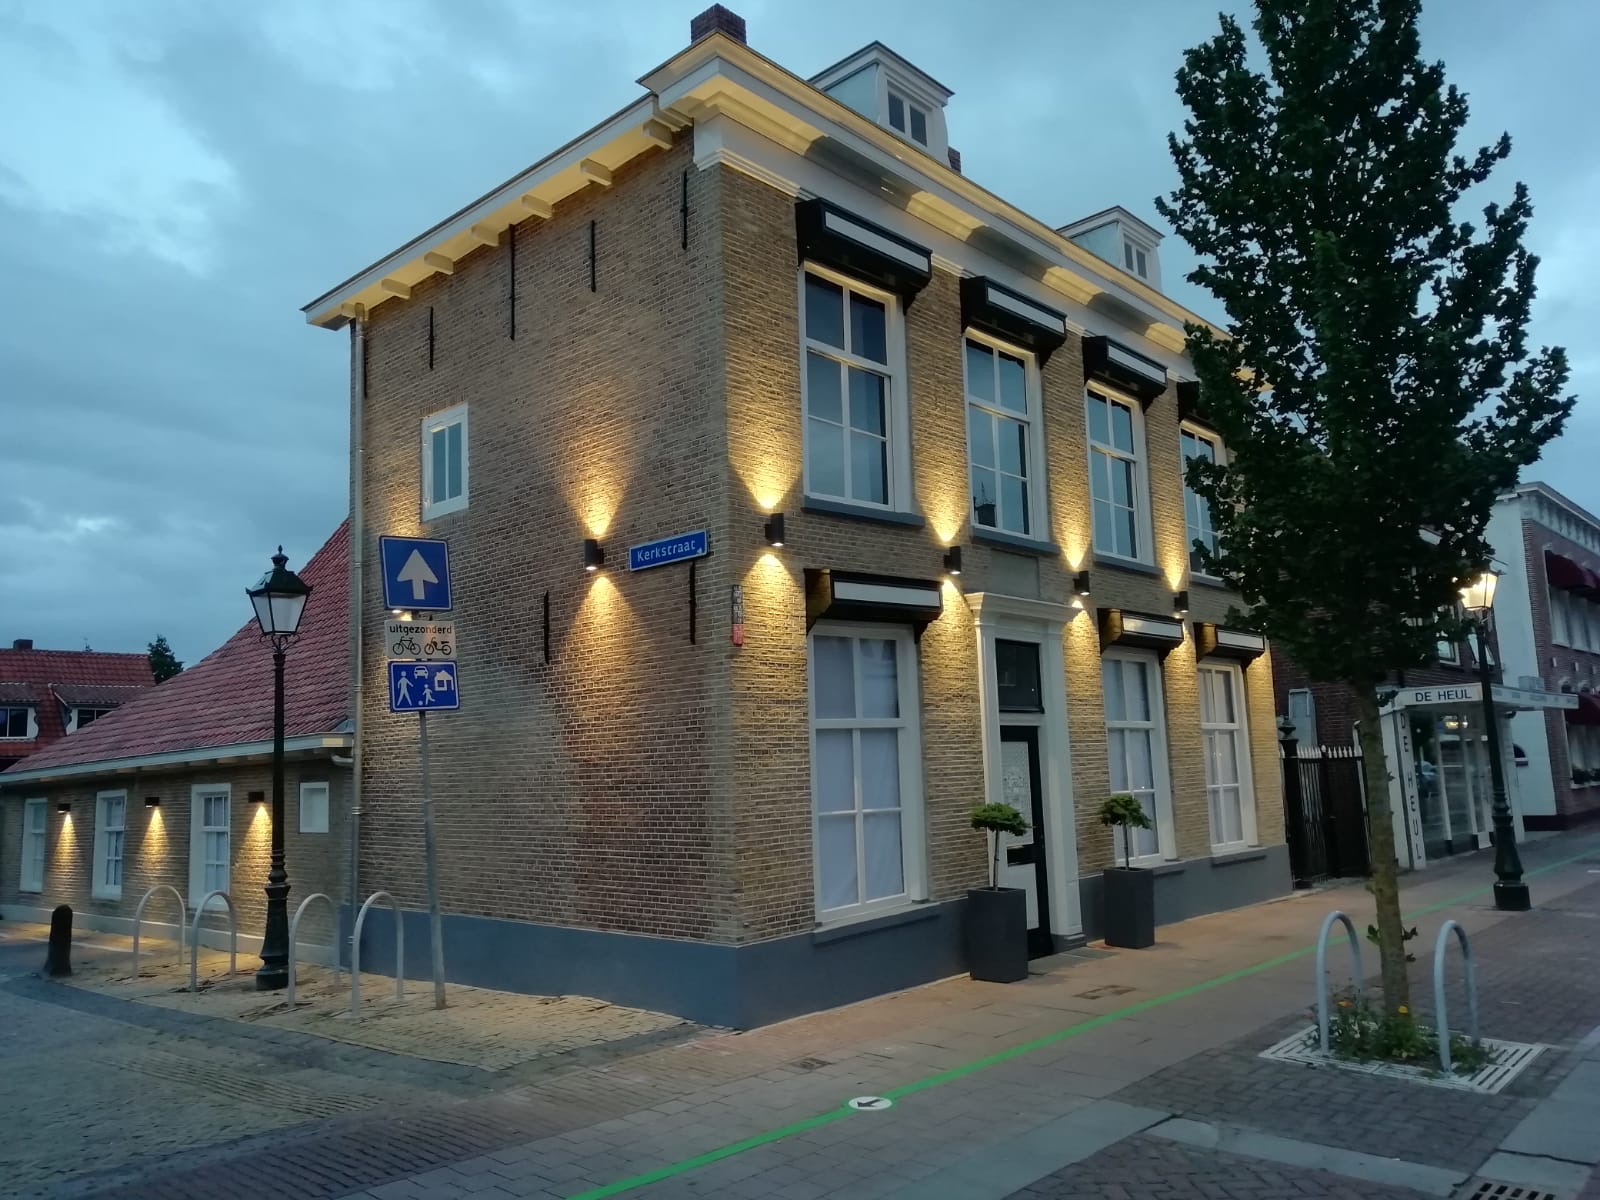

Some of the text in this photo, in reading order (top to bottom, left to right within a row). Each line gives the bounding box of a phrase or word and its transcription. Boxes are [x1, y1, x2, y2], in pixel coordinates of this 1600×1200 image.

[637, 540, 696, 562] Kerkstraat
[389, 623, 452, 635] uitgezonderd
[1415, 689, 1472, 702] DE HEUL
[1400, 713, 1422, 860] DE HEUL
